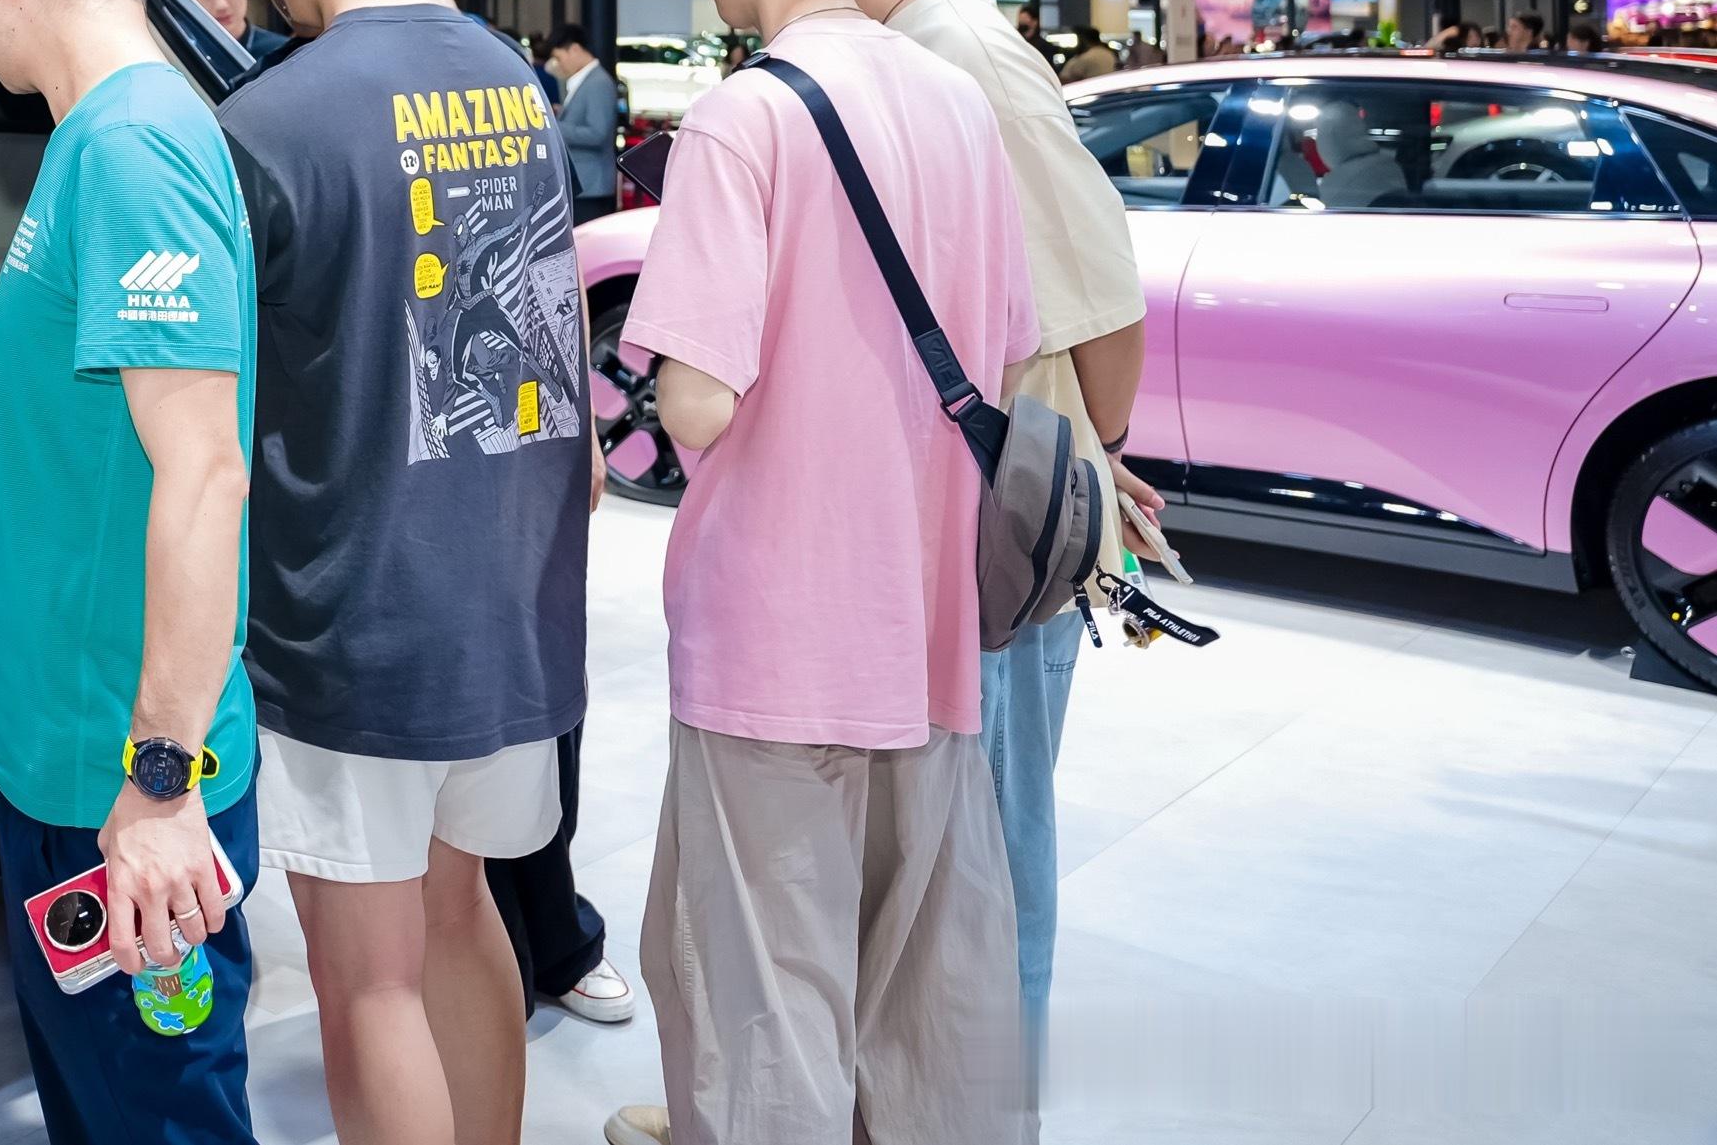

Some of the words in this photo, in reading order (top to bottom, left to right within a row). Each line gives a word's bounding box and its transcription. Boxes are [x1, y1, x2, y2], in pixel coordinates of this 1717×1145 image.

[392, 85, 546, 143] AMAZING
[422, 135, 532, 174] FANTASY
[474, 175, 518, 197] SPIDER
[481, 194, 514, 212] MAN
[127, 294, 191, 309] HKAAA
[1142, 607, 1162, 622] FILA
[1086, 620, 1099, 641] FILA
